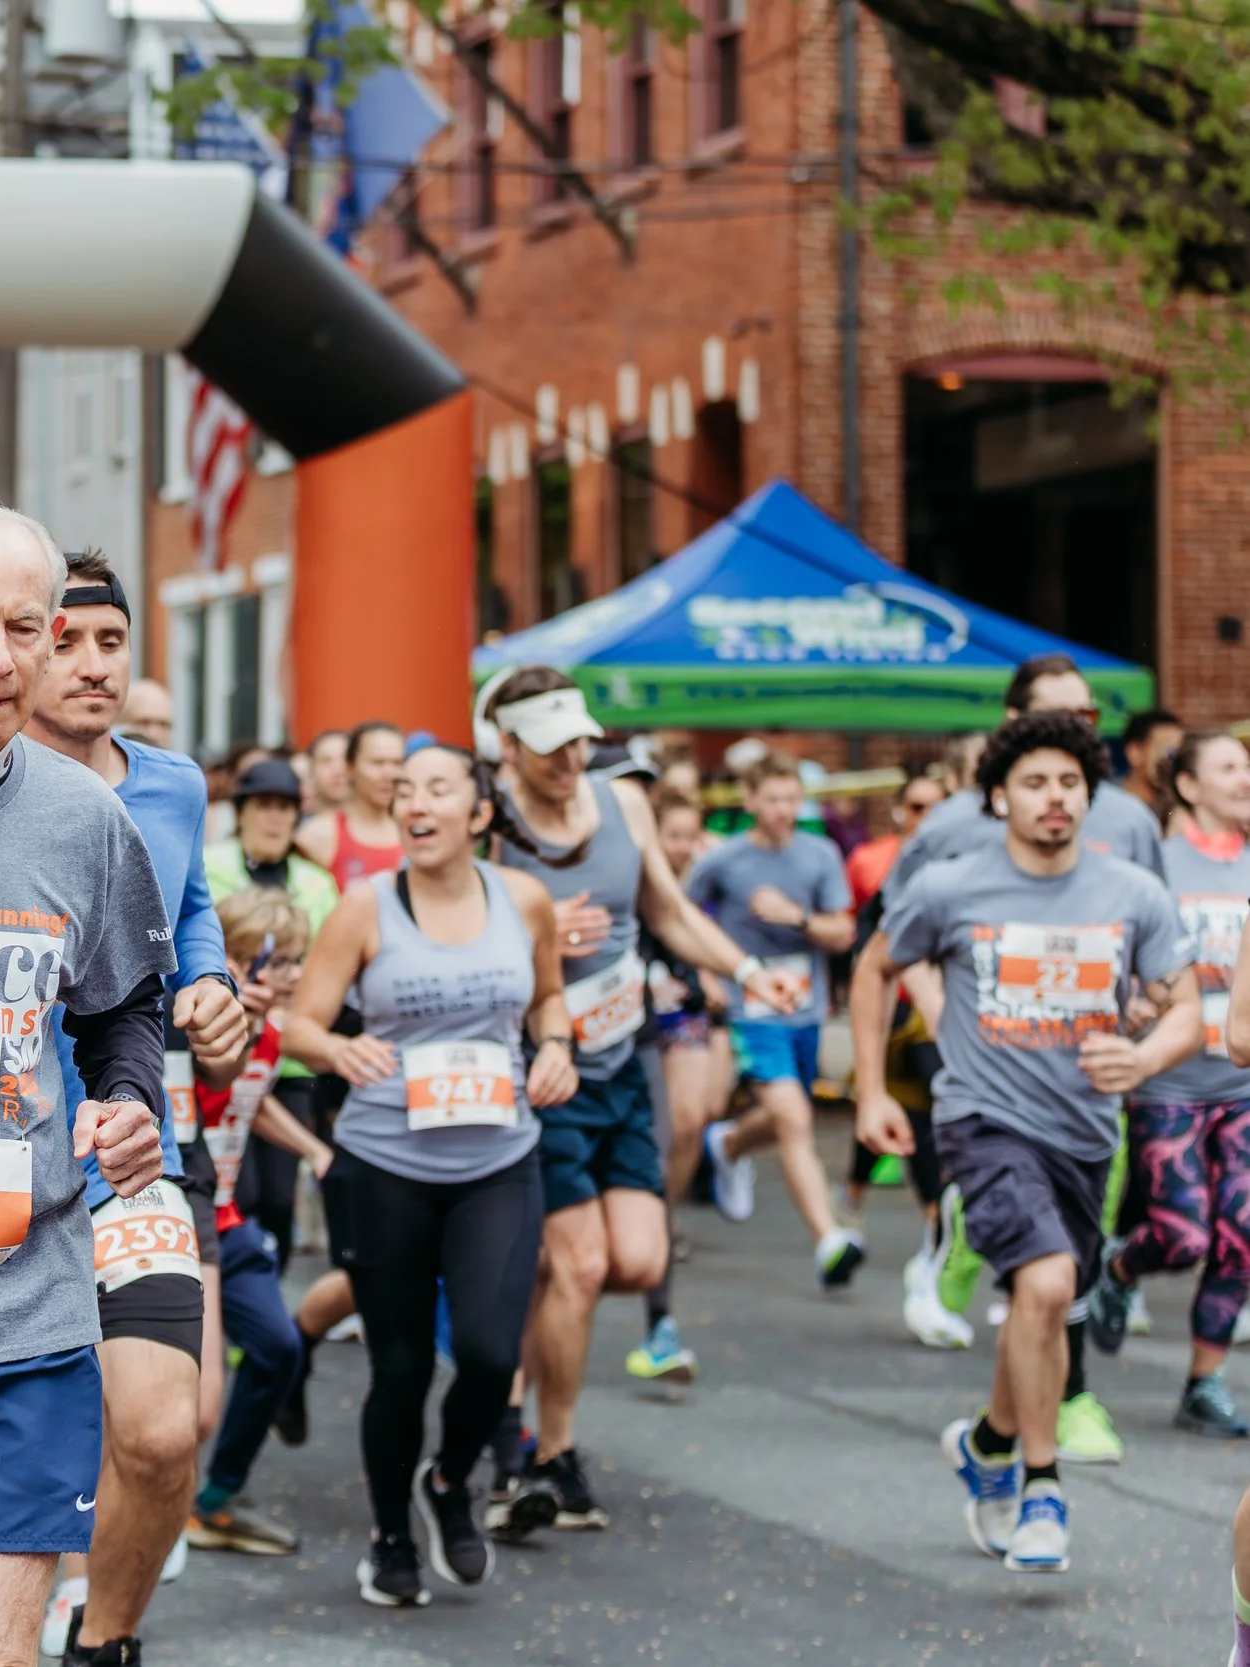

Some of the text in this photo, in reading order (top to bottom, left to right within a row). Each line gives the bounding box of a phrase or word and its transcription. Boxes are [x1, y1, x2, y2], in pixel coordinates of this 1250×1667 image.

[1037, 961, 1079, 987] 22
[428, 1076, 497, 1103] 947
[96, 1219, 197, 1260] 2392
